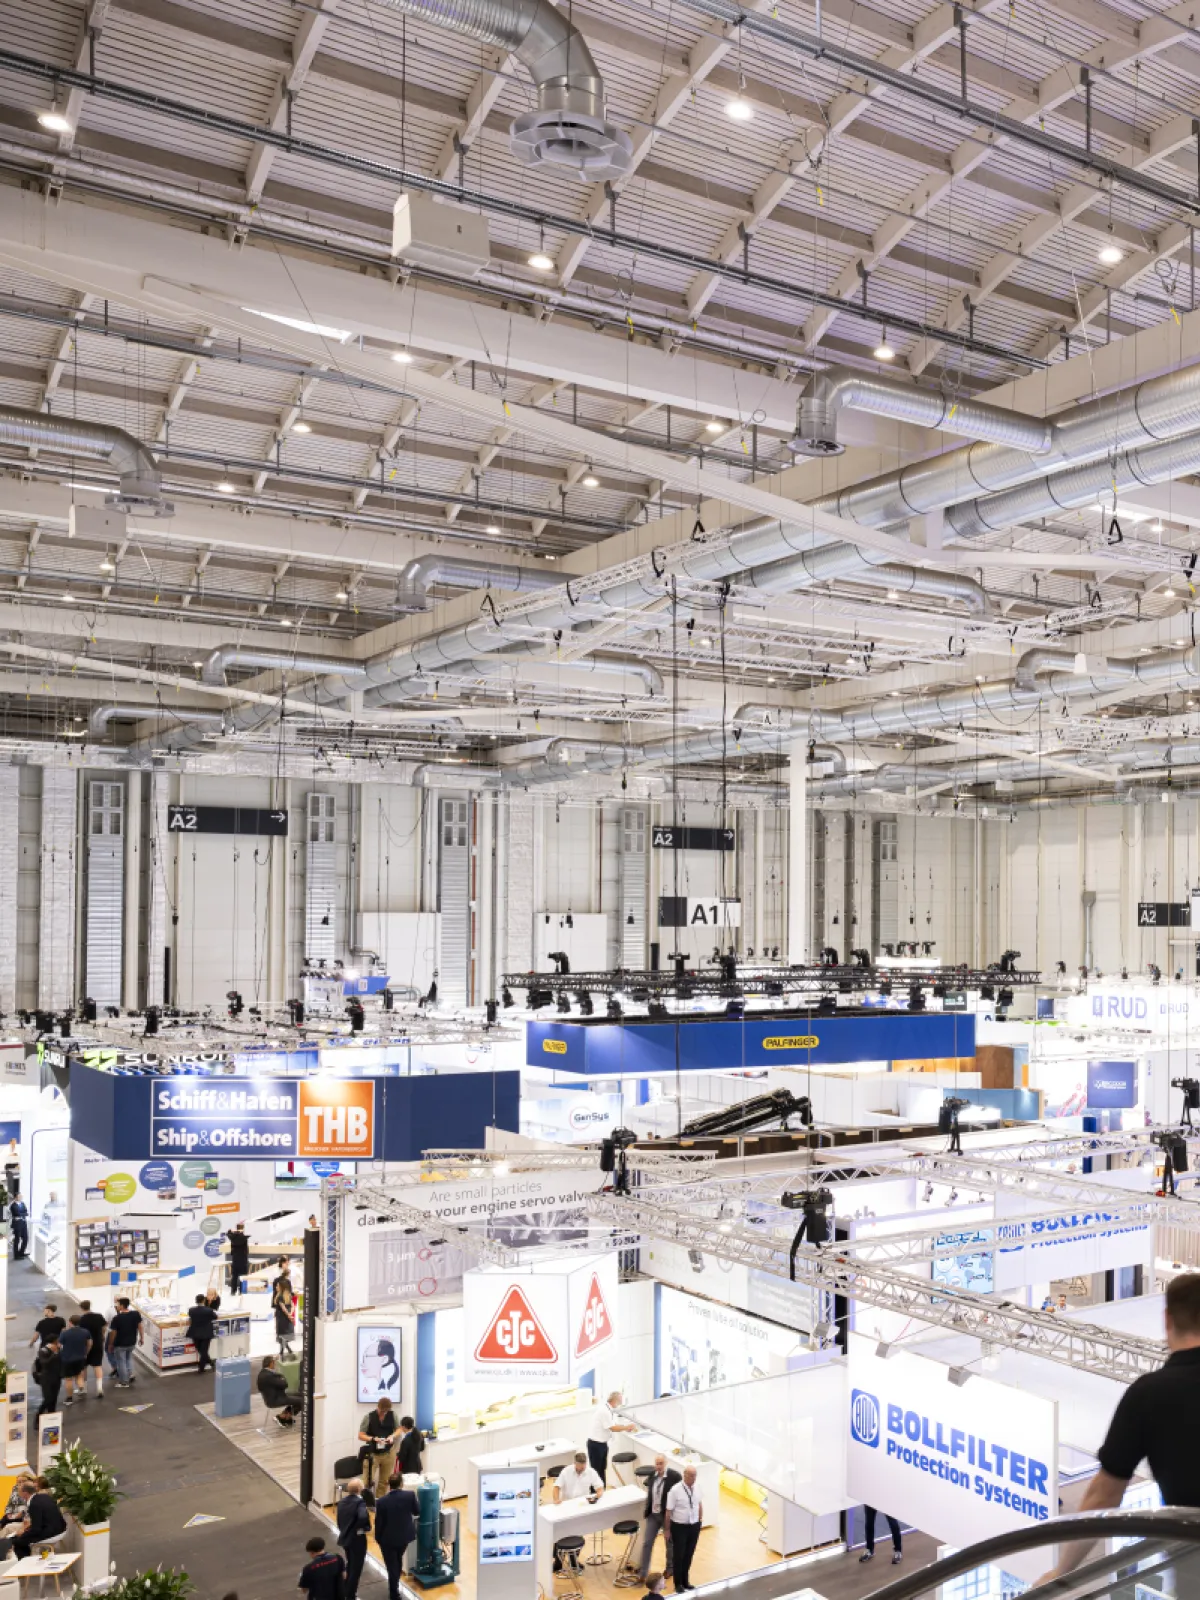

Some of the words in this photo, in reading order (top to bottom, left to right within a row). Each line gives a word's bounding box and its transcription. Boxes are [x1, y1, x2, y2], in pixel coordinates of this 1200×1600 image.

[170, 814, 197, 829] A2
[654, 833, 673, 846] A2
[691, 904, 718, 925] A1
[1140, 910, 1157, 924] A2
[1107, 996, 1148, 1019] RUD
[1169, 1002, 1189, 1014] RUD
[765, 1038, 816, 1048] PALFINGER
[158, 1089, 293, 1111] Schiff&Hafen
[304, 1106, 368, 1144] THB
[573, 1112, 610, 1122] GenSys
[156, 1128, 293, 1152] Ship&Offshore
[430, 1190, 451, 1203] Are
[455, 1185, 487, 1200] small
[492, 1180, 542, 1199] particles
[435, 1206, 467, 1218] your
[471, 1201, 517, 1214] engine
[520, 1196, 555, 1209] servo
[387, 1252, 394, 1262] 3
[387, 1284, 395, 1295] 6
[584, 1296, 604, 1343] CJC
[495, 1310, 536, 1355] CJC
[887, 1402, 1049, 1496] BOLLFILTER
[886, 1437, 970, 1490] Protection
[974, 1474, 1049, 1521] Systems
